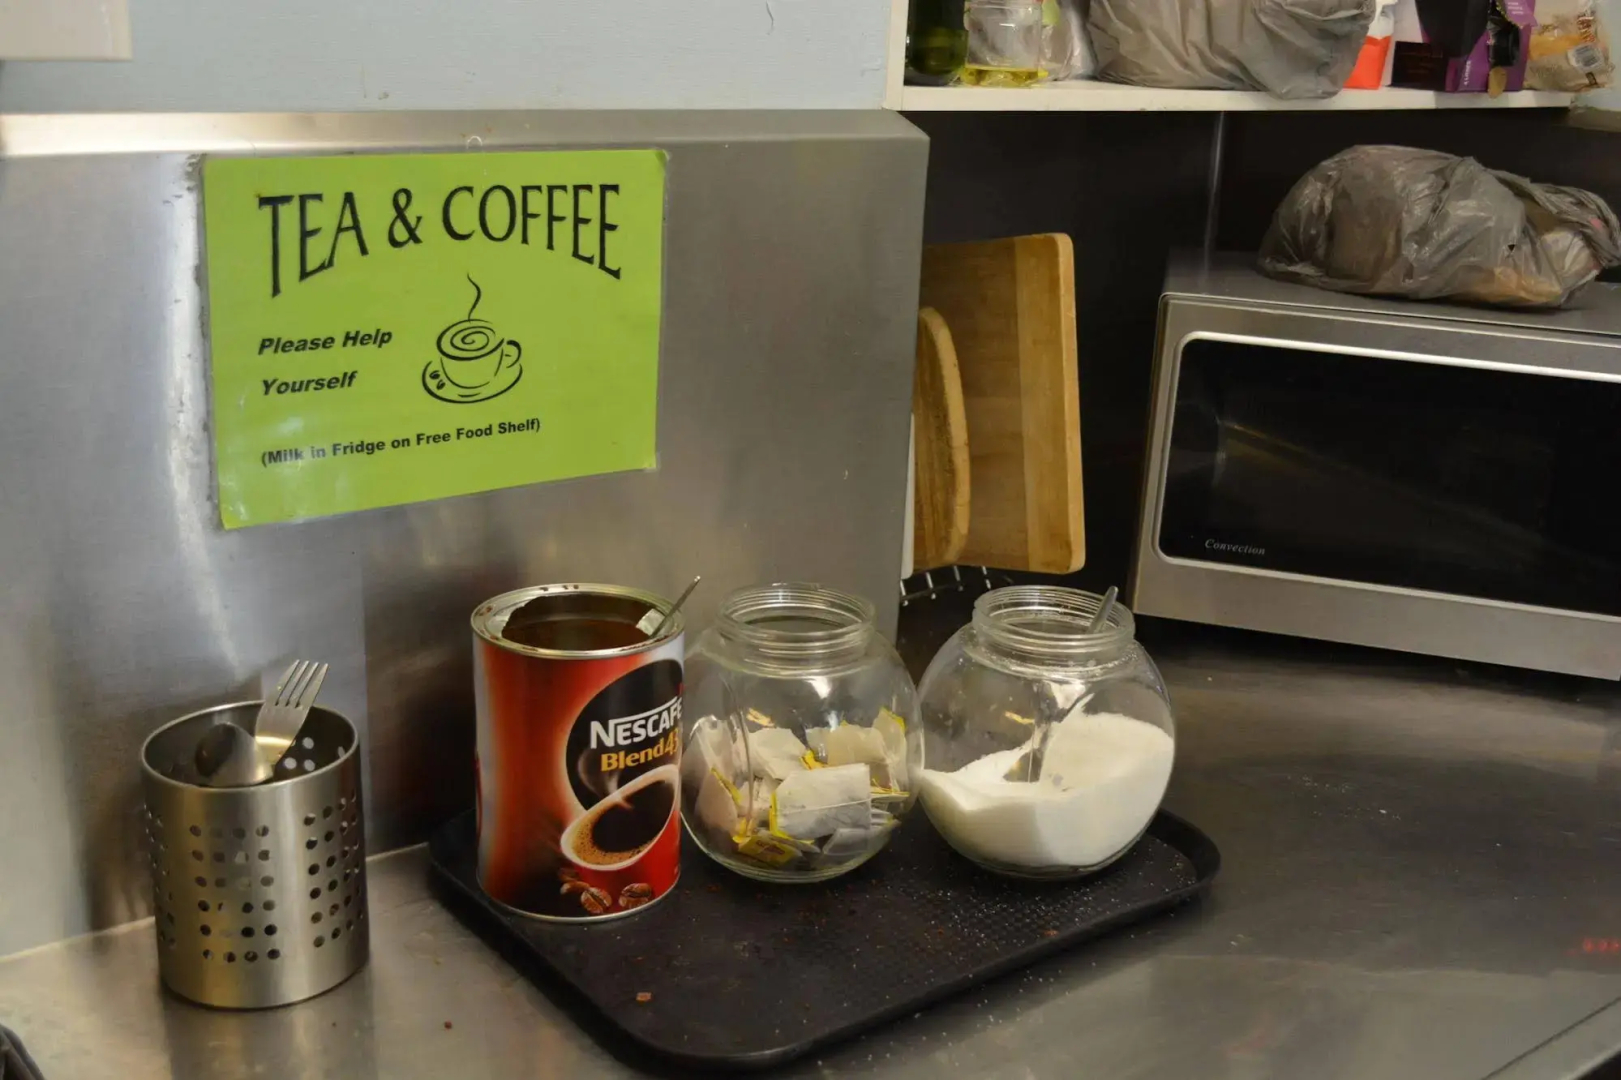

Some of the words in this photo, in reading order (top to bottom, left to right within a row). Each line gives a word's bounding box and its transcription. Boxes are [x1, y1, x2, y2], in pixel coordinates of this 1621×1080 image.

[258, 191, 369, 298] TEA
[386, 188, 423, 249] &
[442, 183, 621, 280] COFFEE
[258, 337, 336, 356] Please
[342, 328, 393, 349] Help
[261, 370, 358, 396] Yourself
[261, 449, 304, 468] (Milk
[310, 446, 326, 459] in
[332, 440, 386, 457] Fridge
[391, 436, 411, 450] on
[416, 432, 451, 447] Free
[456, 424, 493, 440] Food
[497, 417, 541, 434] Shelf)
[1204, 538, 1266, 555] Convection
[601, 738, 664, 772] Blend
